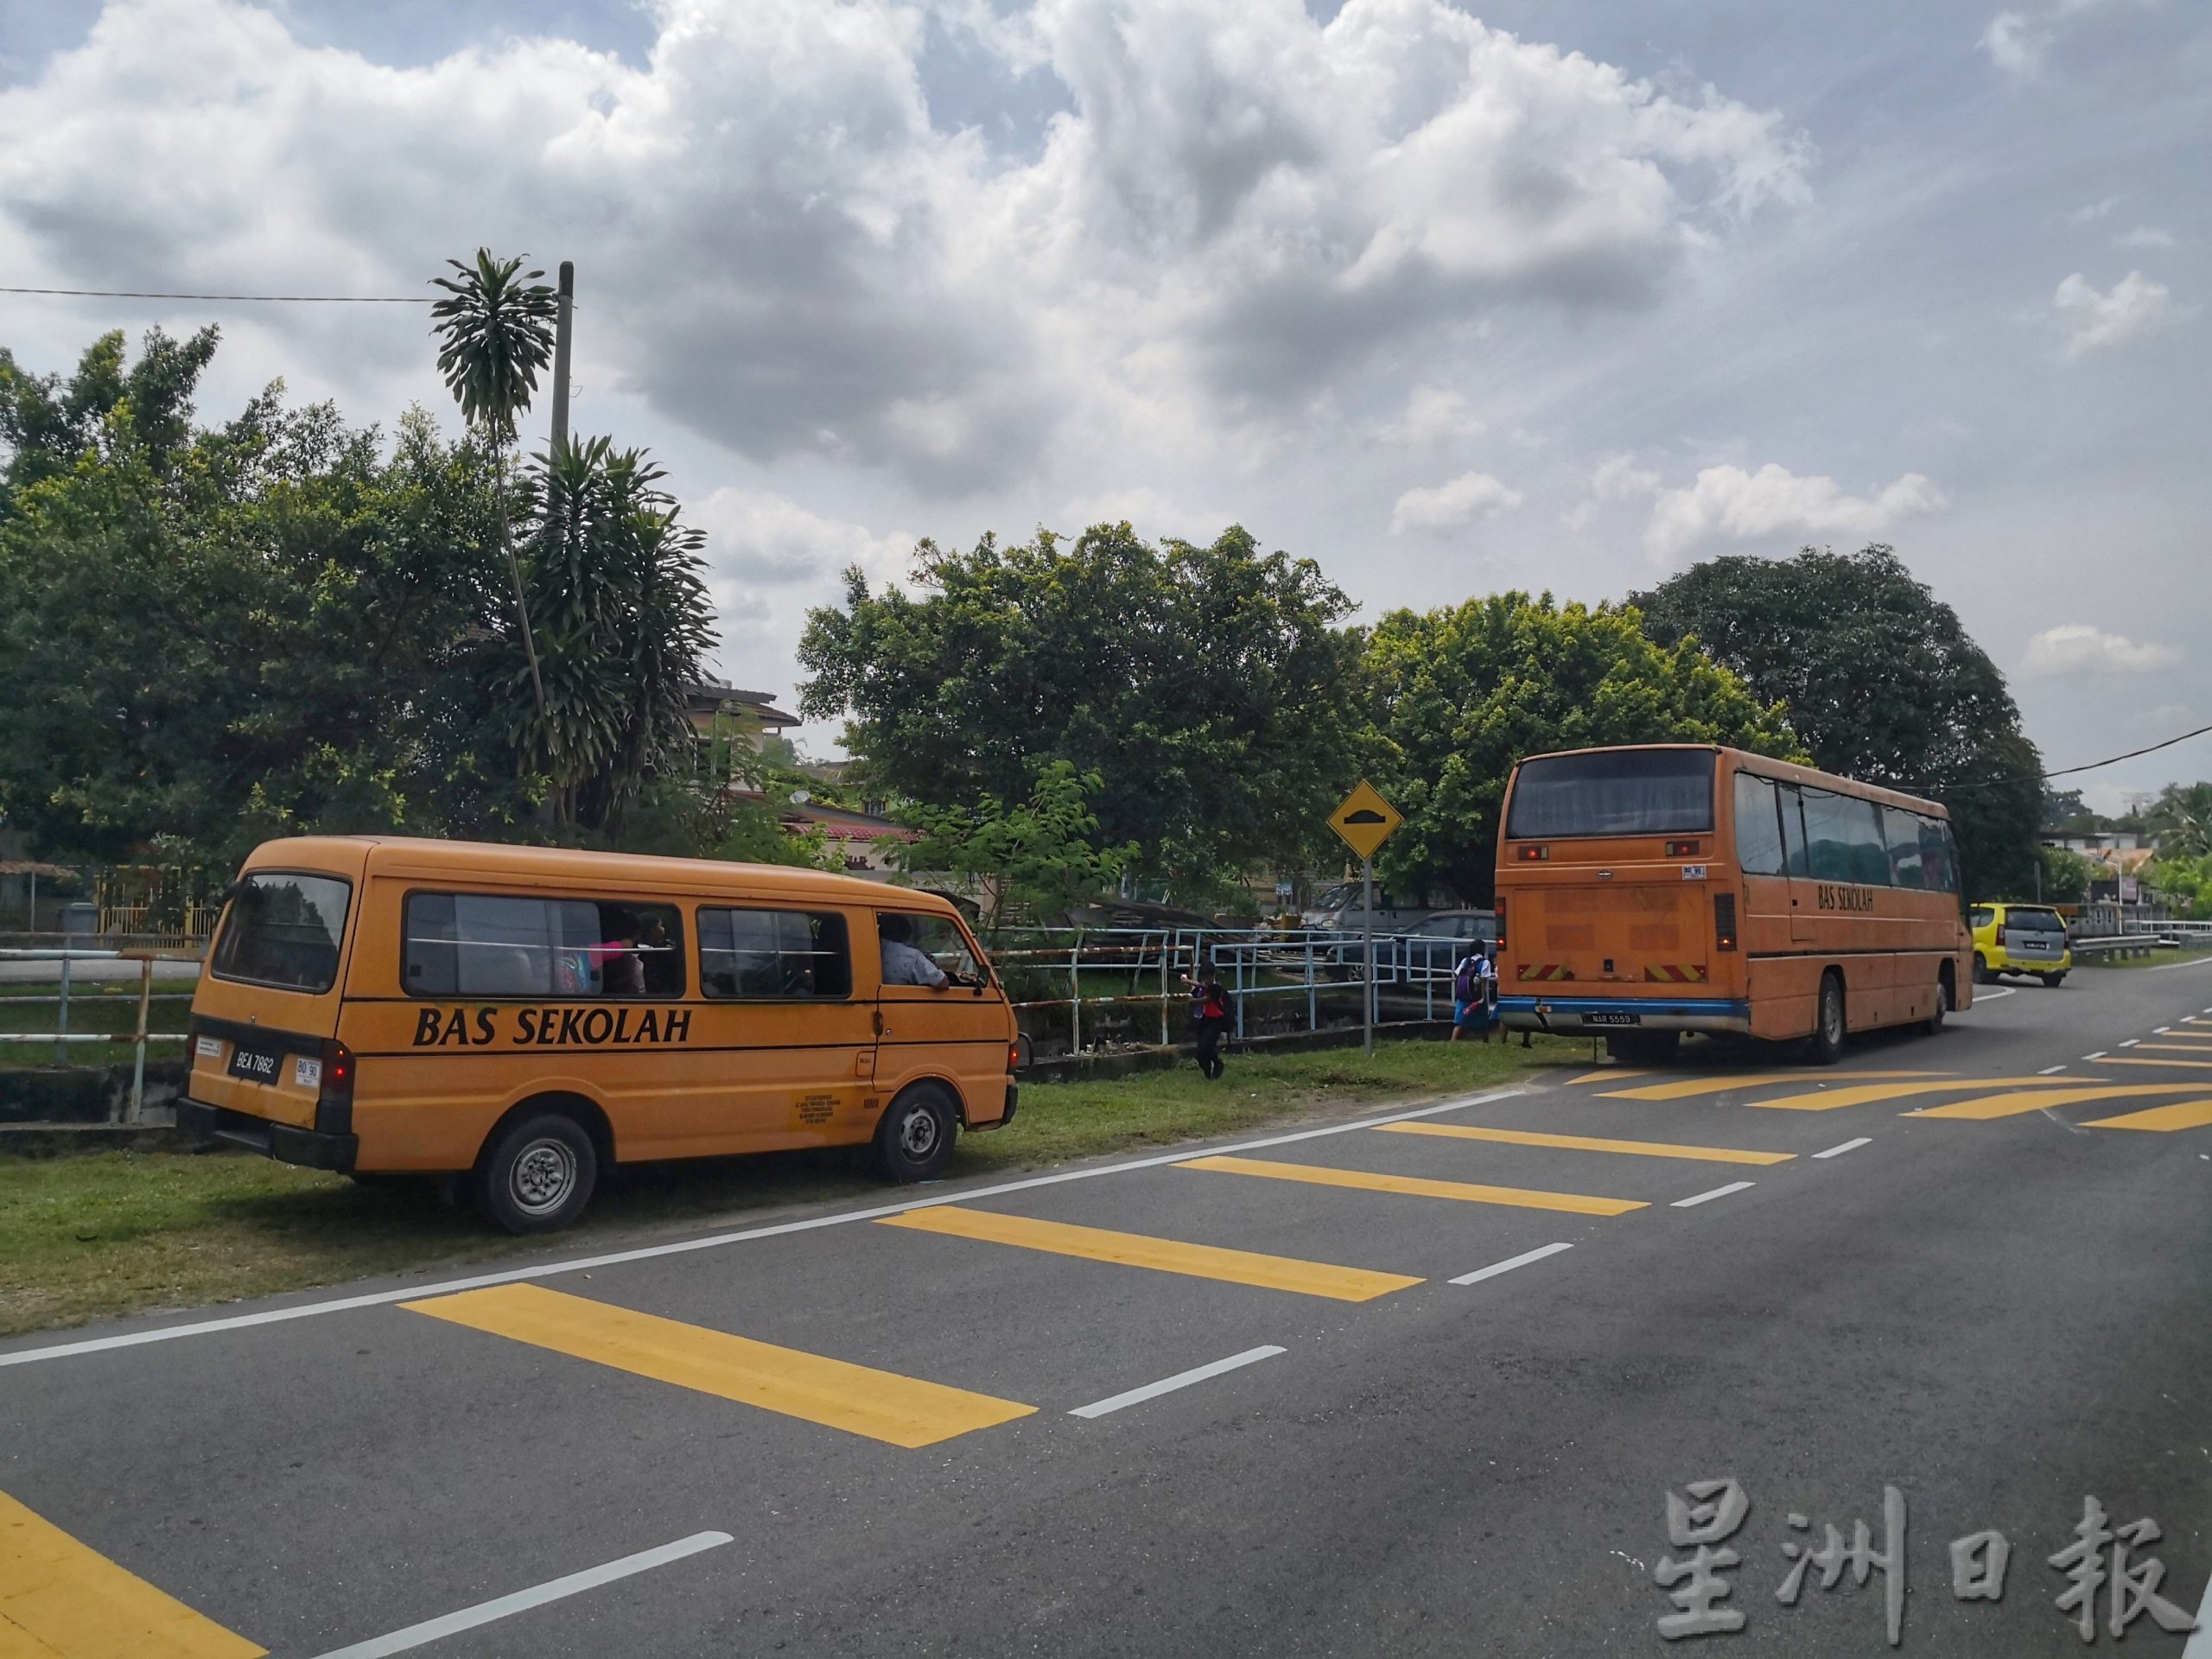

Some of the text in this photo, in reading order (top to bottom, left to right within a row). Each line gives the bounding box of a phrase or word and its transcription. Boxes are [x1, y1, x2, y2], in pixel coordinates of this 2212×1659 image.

[1818, 885, 1873, 912] BAS SEKOLAH
[412, 1007, 692, 1046] BAS SEKOLAH
[1609, 1014, 1630, 1023] 5559
[236, 1052, 274, 1074] BEA 7862
[297, 1059, 306, 1074] 80
[308, 1064, 317, 1077] 90
